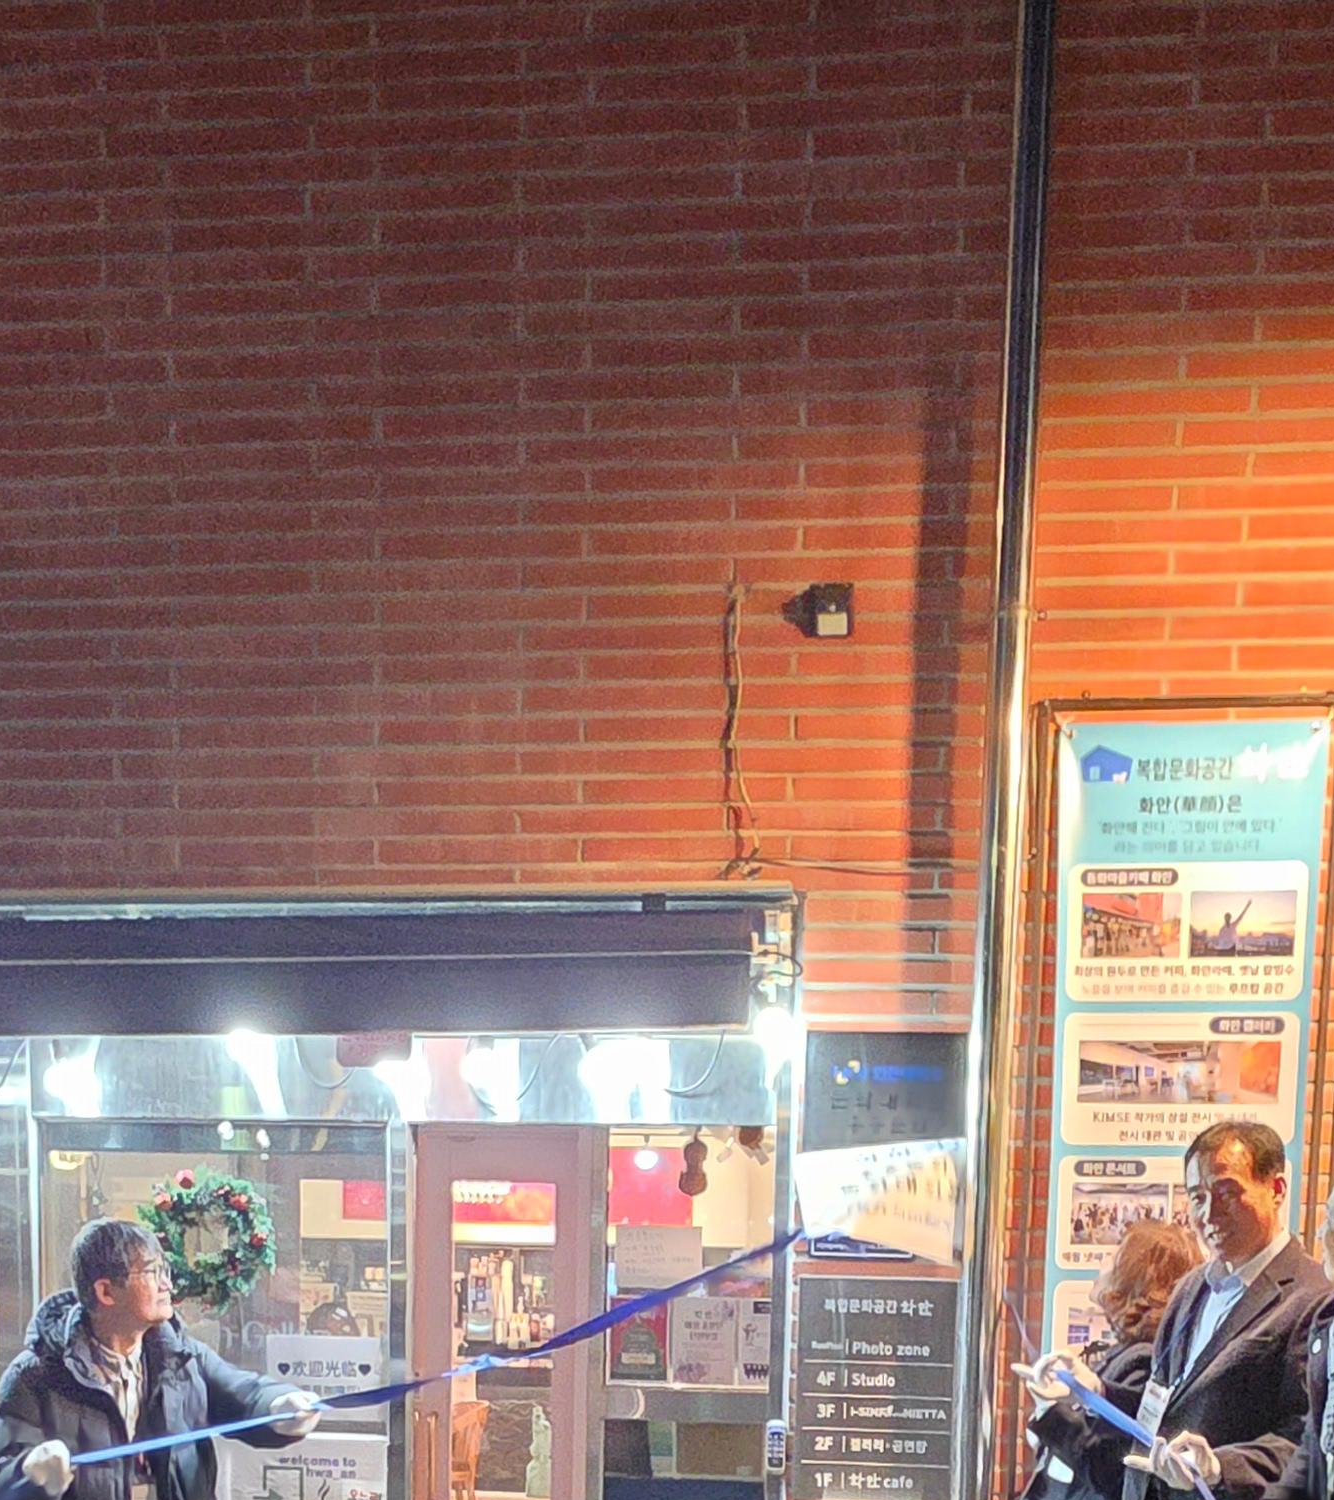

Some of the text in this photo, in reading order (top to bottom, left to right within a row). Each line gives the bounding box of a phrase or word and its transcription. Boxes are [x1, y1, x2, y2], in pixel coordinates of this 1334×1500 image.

[1137, 755, 1234, 782] 복합문화공간
[824, 1298, 935, 1317] 복합문화공간 화안
[852, 1341, 894, 1357] Photo
[896, 1345, 931, 1358] zone
[291, 1359, 358, 1378] 欢迎光临
[816, 1370, 896, 1388] 4F Studio
[816, 1403, 836, 1419] 3F
[814, 1436, 834, 1452] 2F
[278, 1455, 357, 1467] welcome to
[814, 1472, 834, 1489] 1F
